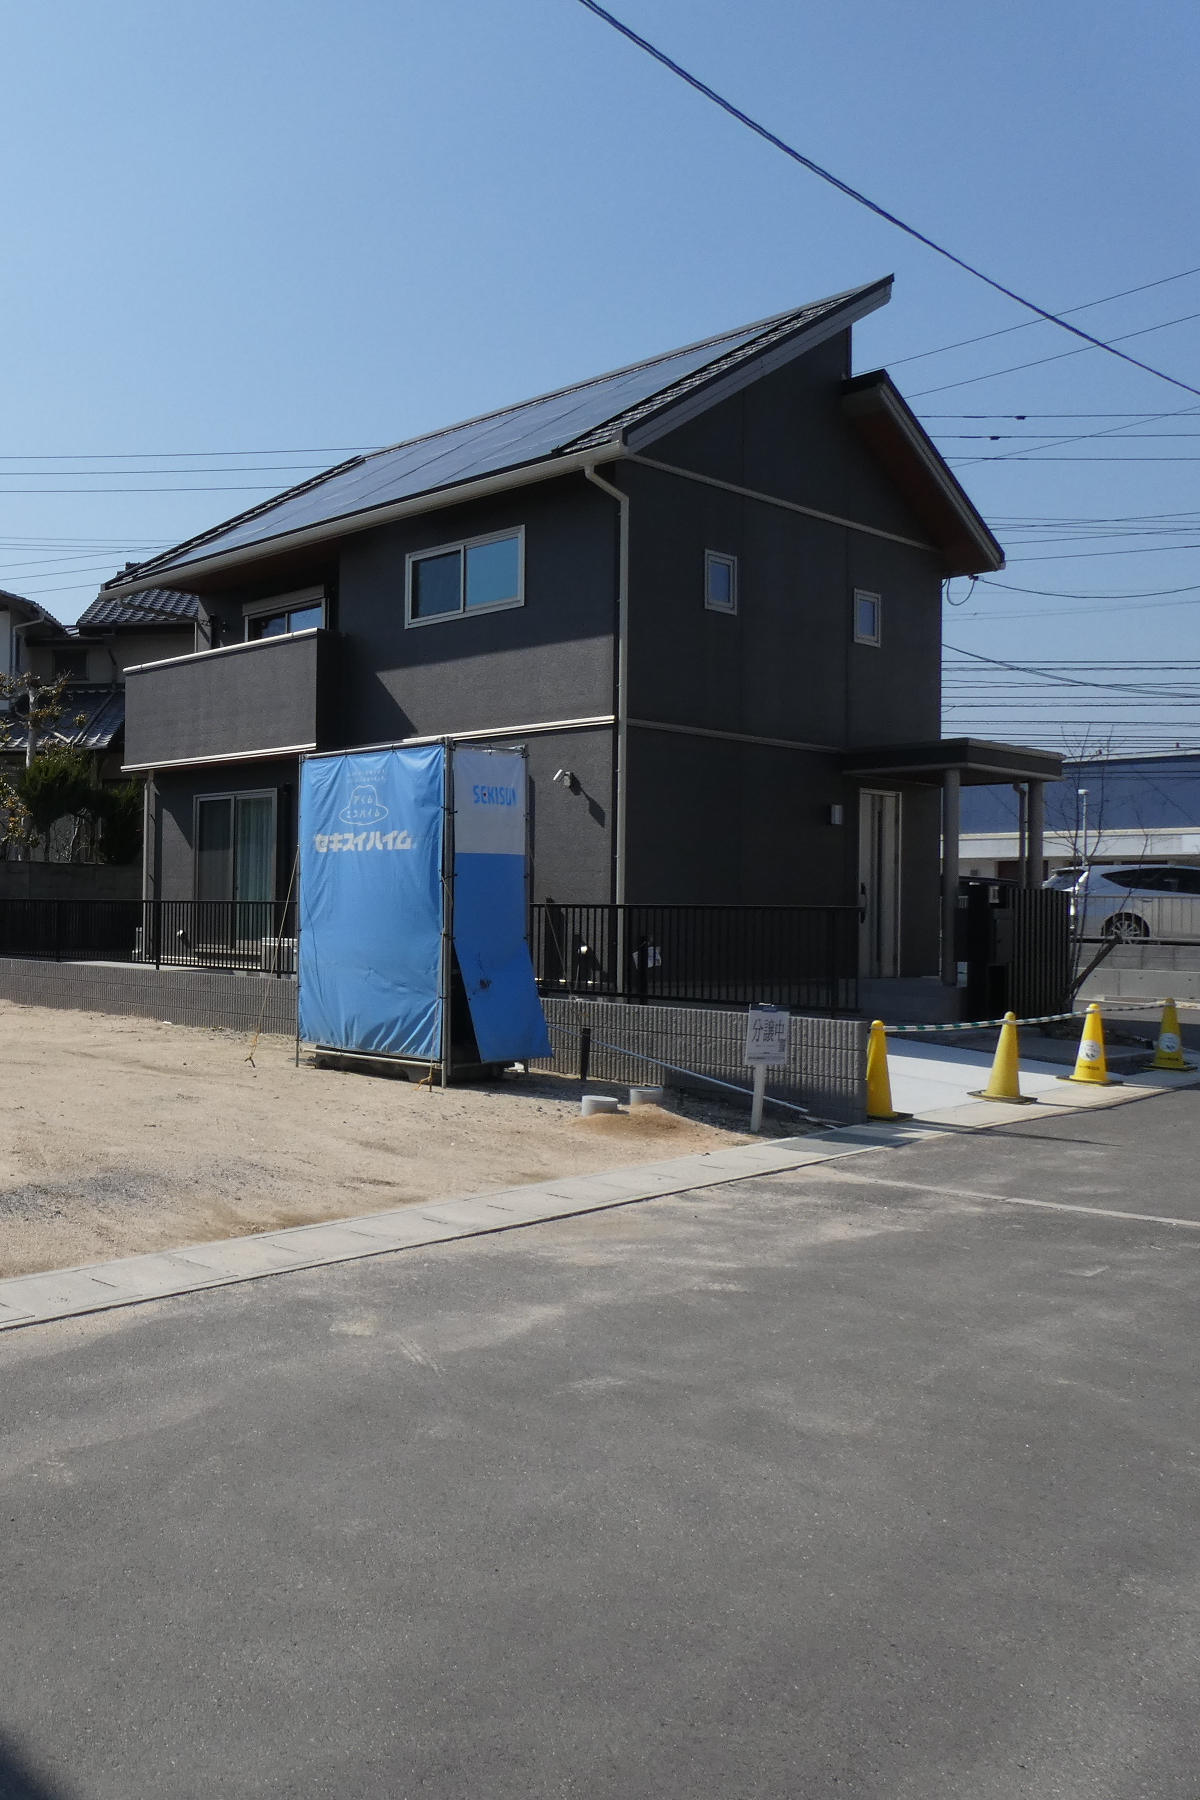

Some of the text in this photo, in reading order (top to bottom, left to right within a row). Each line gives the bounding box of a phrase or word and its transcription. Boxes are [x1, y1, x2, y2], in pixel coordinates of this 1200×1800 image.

[472, 784, 516, 806] SEKISUI
[314, 830, 412, 853] セキスイハイム
[752, 1018, 785, 1043] 分譲中
